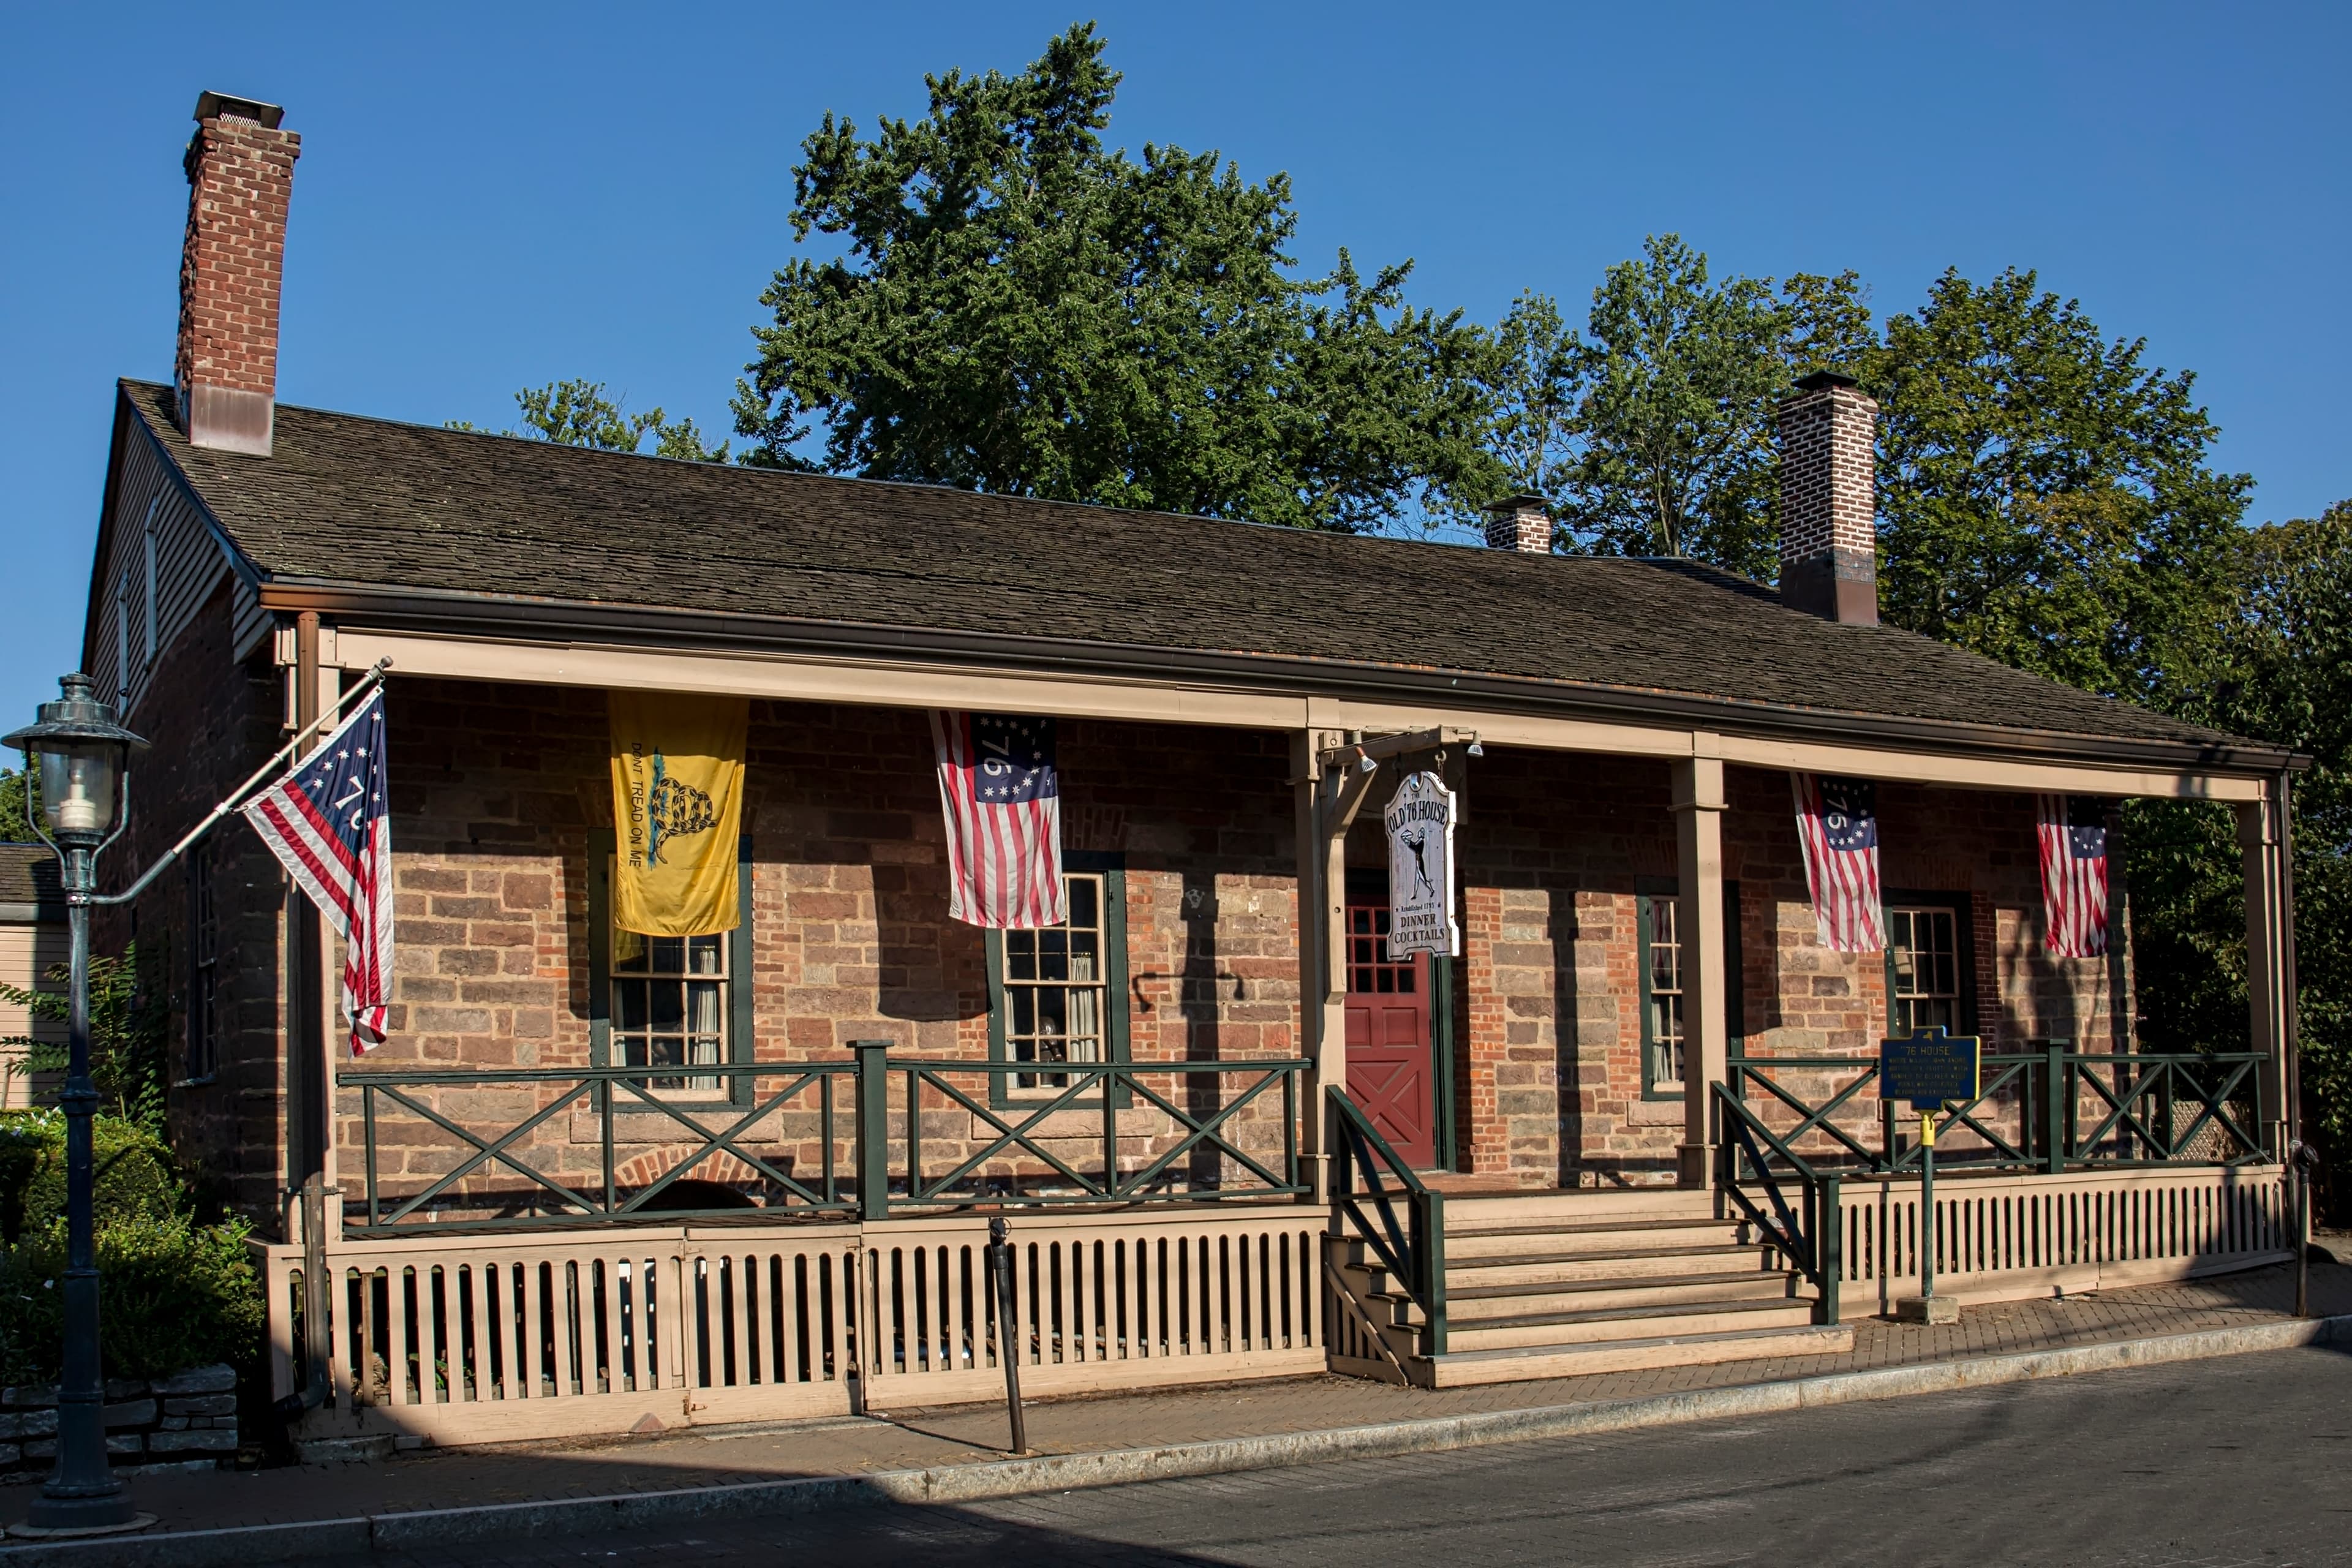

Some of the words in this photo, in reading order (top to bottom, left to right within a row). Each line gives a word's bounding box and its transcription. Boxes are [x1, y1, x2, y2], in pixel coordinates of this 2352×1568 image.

[631, 742, 643, 775] DONT
[981, 736, 1012, 777] 76
[631, 781, 644, 823] TREAD
[1389, 807, 1406, 832] OLD
[1418, 800, 1448, 825] HOUSE
[1826, 796, 1848, 829] 76
[631, 827, 643, 845] ON
[629, 850, 643, 868] ME
[1395, 928, 1444, 943] COCKTAILS
[1401, 913, 1436, 927] DINNER
